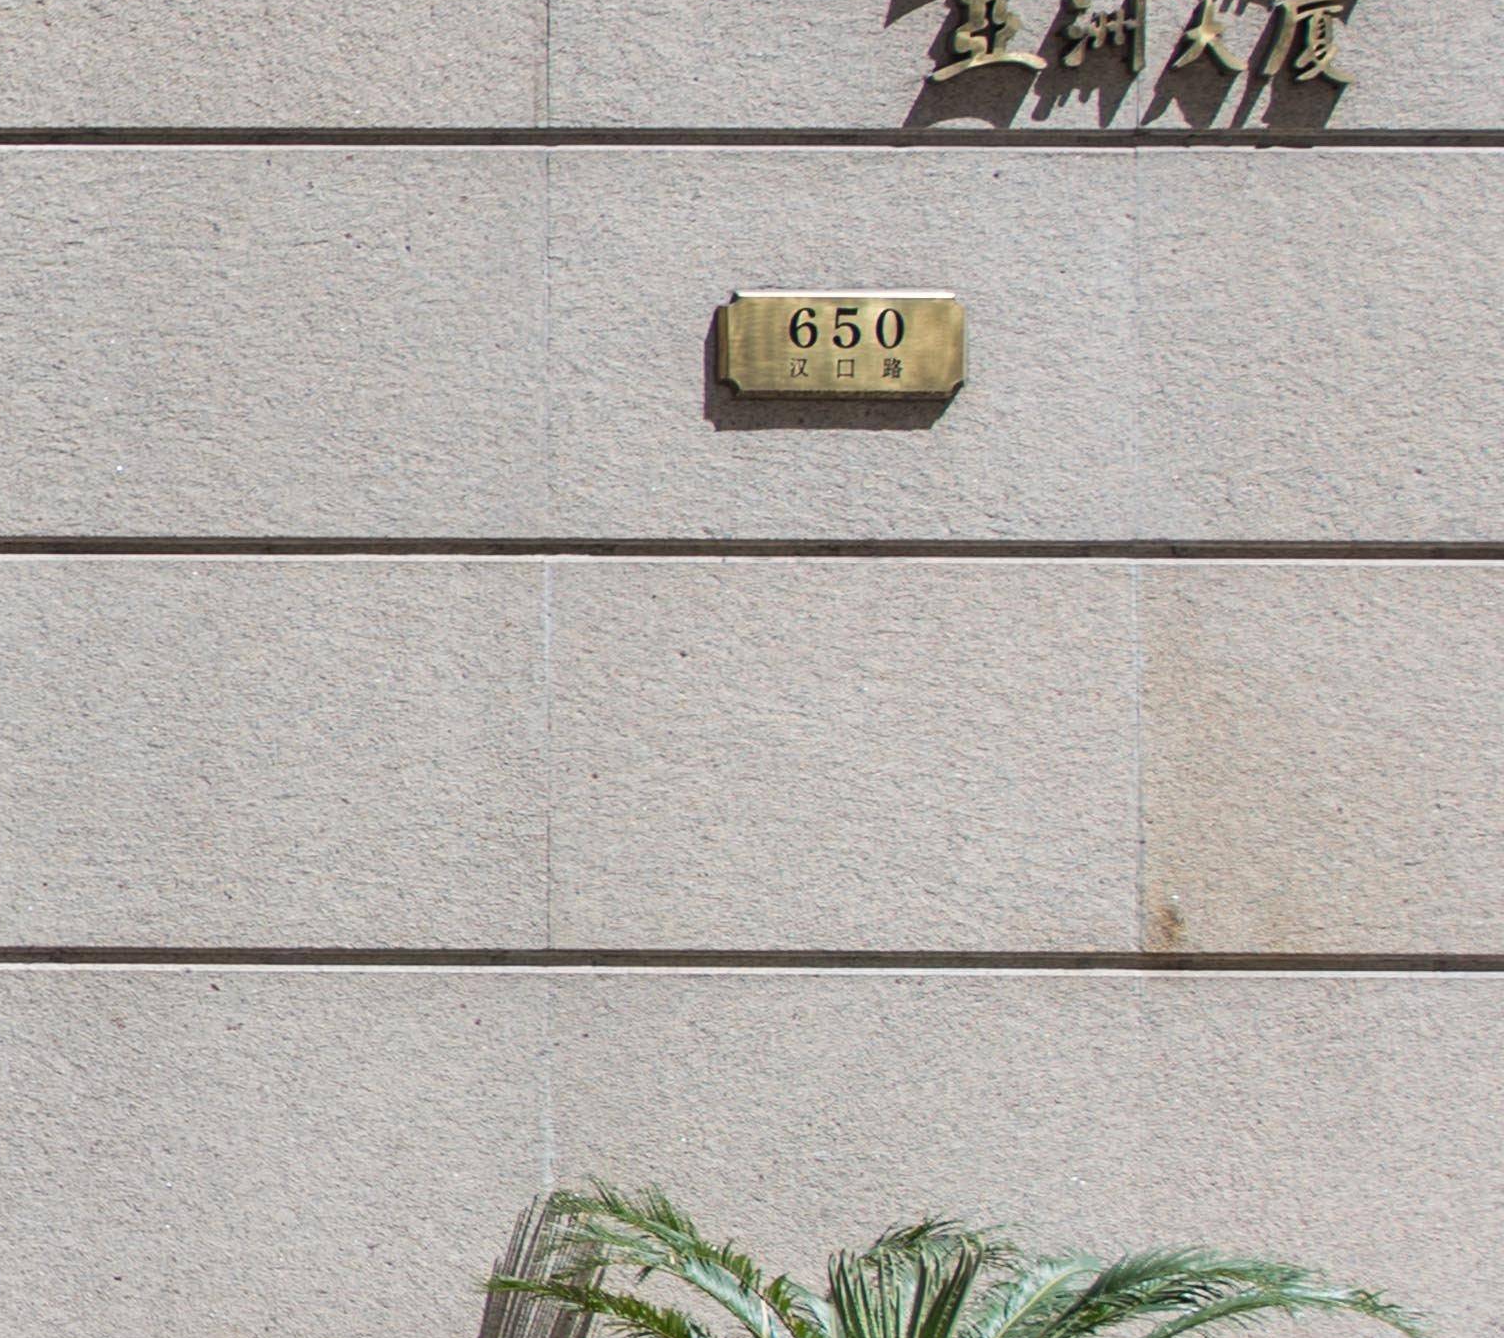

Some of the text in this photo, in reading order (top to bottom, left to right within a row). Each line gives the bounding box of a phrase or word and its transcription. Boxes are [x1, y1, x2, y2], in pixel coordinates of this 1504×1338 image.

[788, 307, 905, 349] 650
[789, 357, 904, 379] 汉口路
